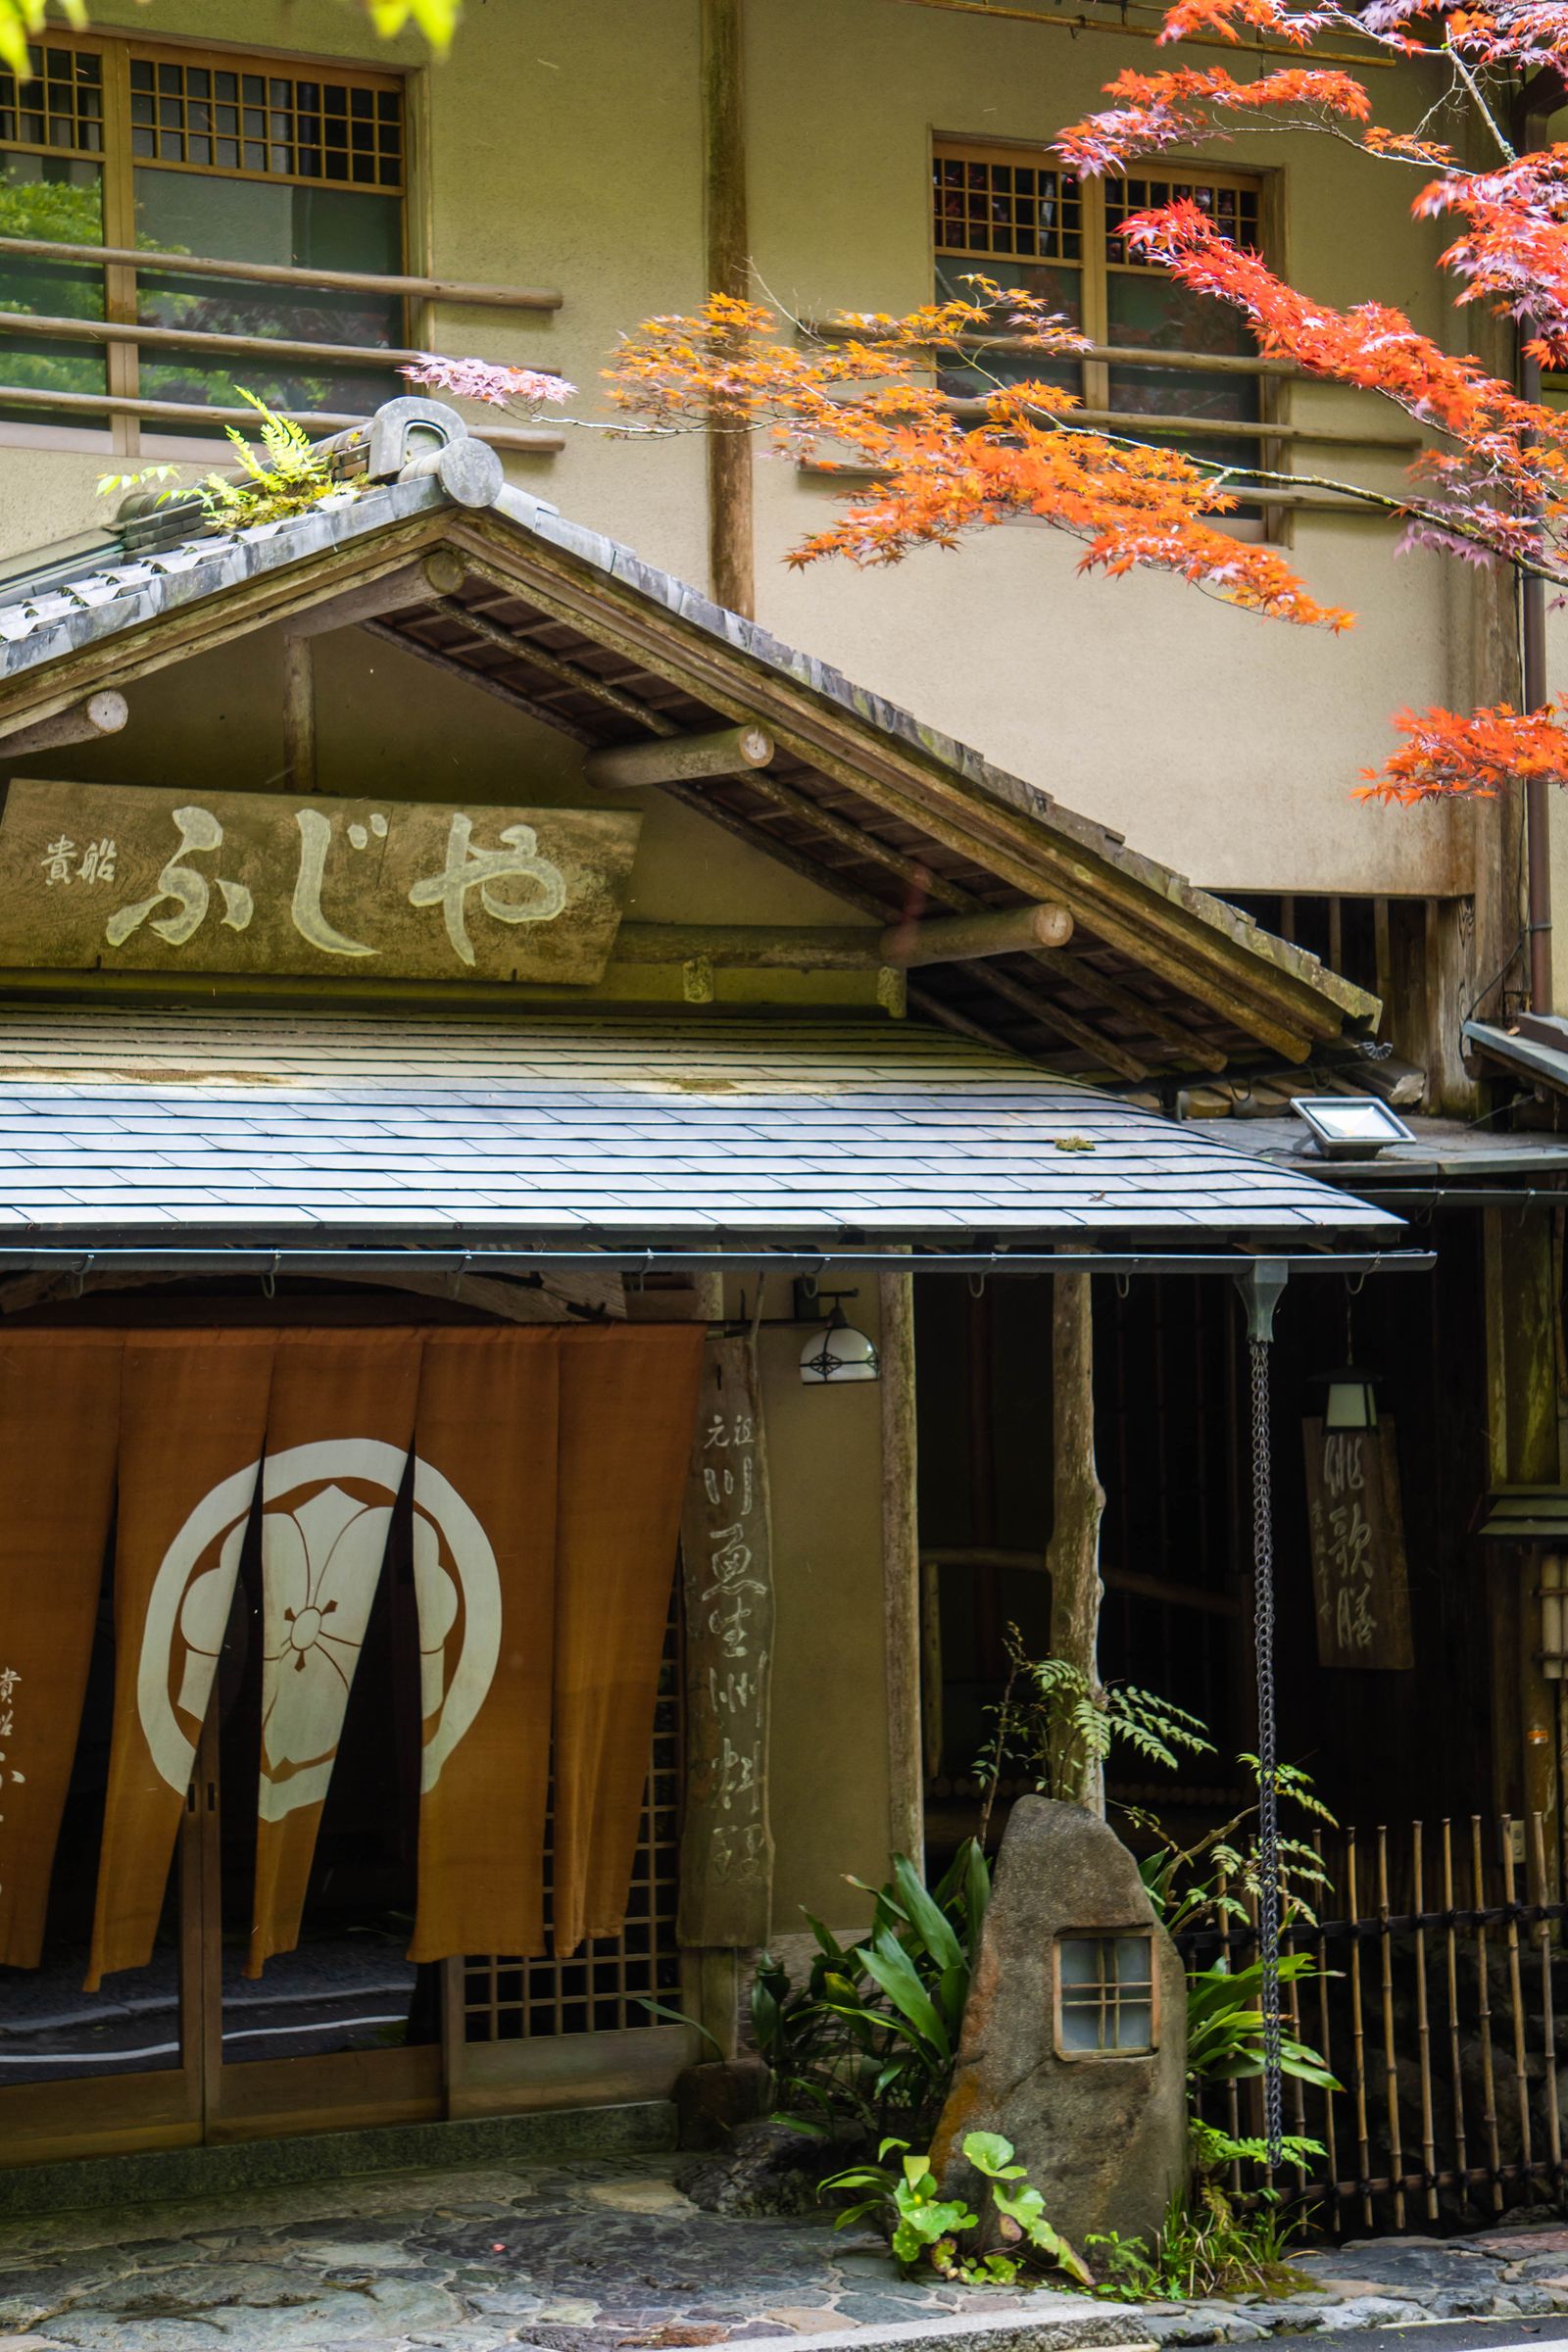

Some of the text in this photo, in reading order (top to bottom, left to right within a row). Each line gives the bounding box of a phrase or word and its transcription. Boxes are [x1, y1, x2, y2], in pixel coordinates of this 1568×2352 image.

[40, 806, 567, 966] 貴船 ふじや
[704, 1414, 756, 1449] 元祖
